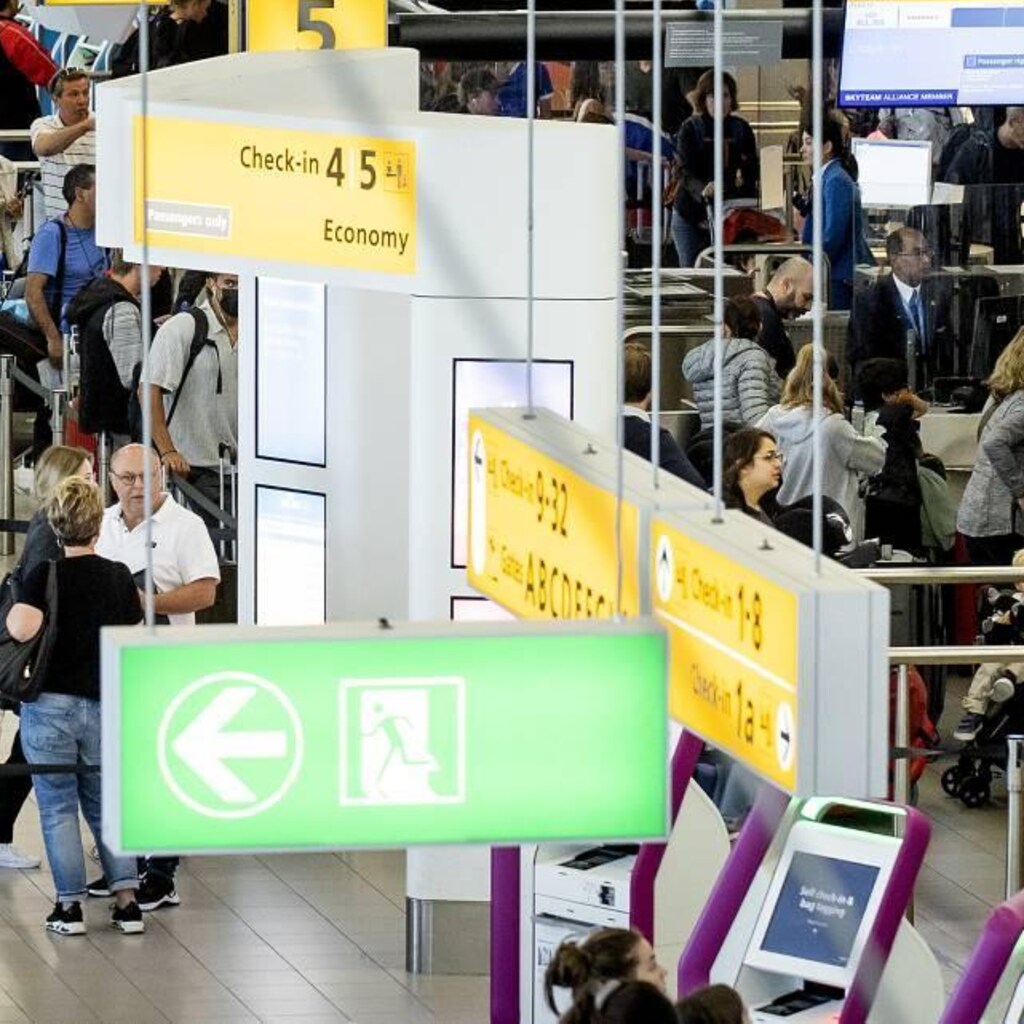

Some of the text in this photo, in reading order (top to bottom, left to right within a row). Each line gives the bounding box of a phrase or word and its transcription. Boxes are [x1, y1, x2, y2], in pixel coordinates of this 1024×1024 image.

[240, 145, 376, 191] Check-in 4 5
[205, 214, 228, 233] only
[324, 219, 410, 255] Economy
[536, 469, 569, 538] 9-32
[738, 584, 764, 652] 1-8
[737, 680, 755, 745] 1a
